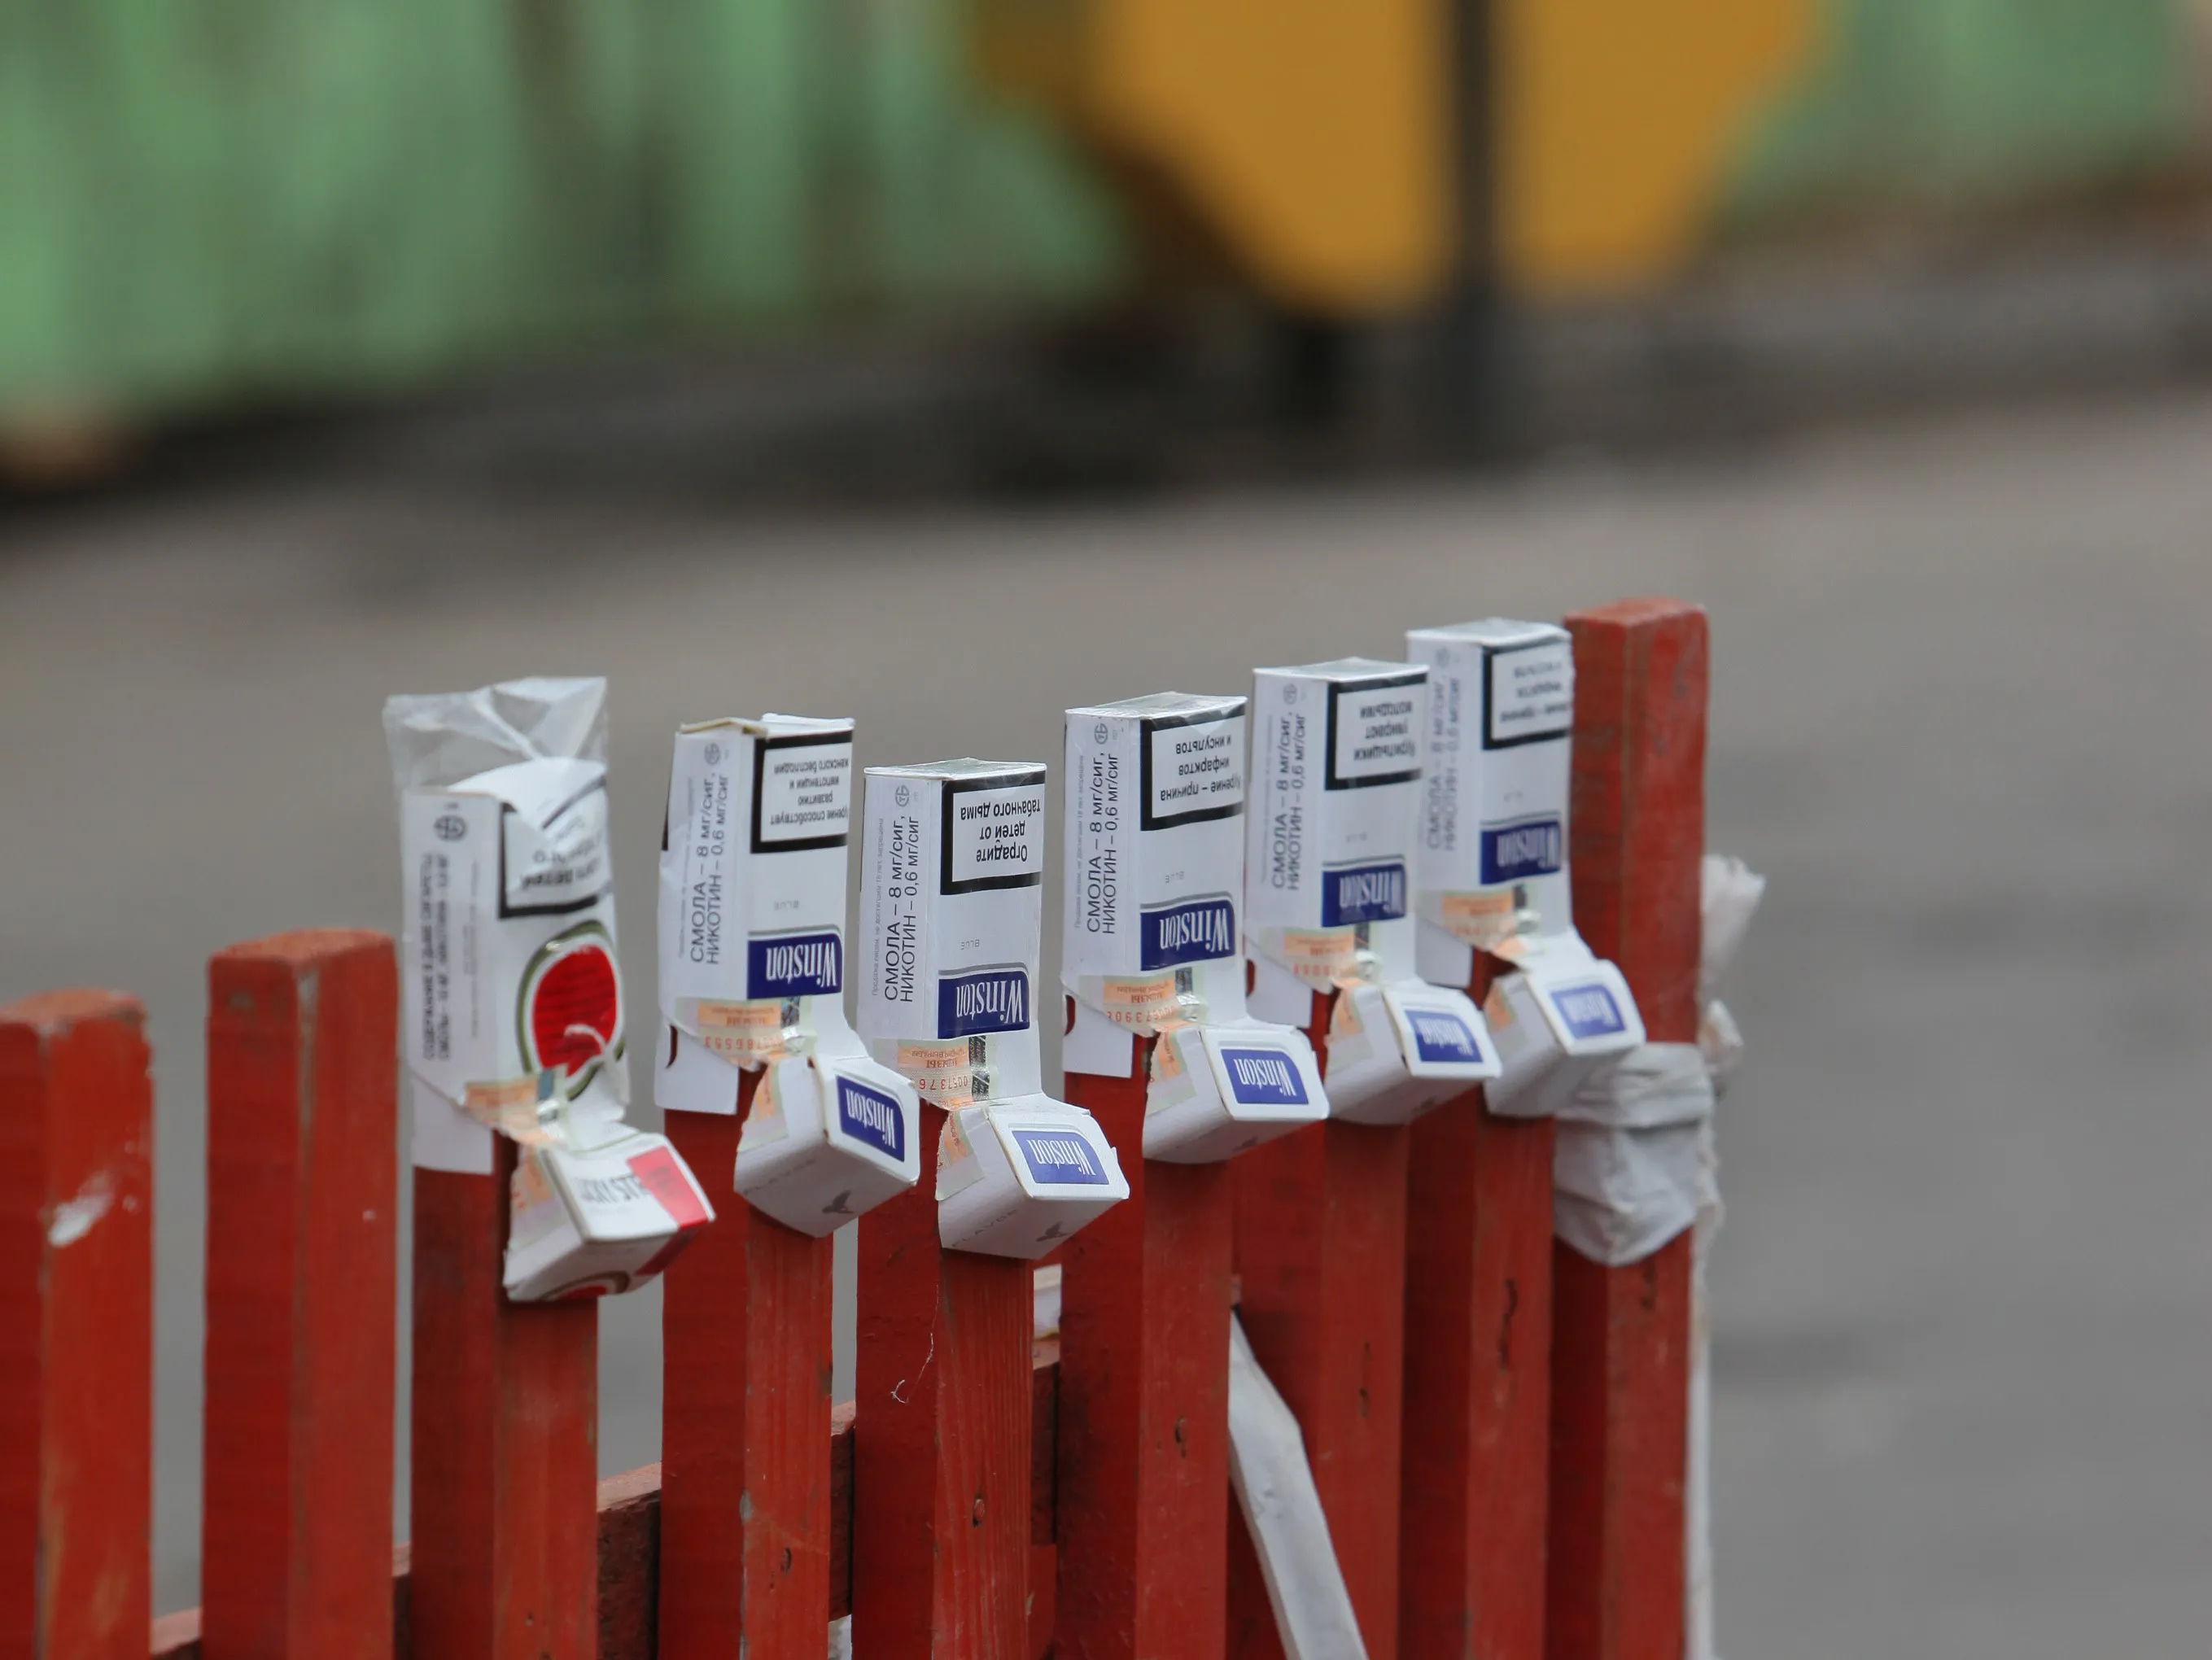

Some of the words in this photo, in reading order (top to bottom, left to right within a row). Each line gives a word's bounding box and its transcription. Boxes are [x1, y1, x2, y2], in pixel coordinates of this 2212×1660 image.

[1175, 735, 1225, 754] инсультов
[1226, 734, 1232, 746] и
[1105, 754, 1119, 802] мг/сиг
[1178, 756, 1230, 776] инфарктов
[1292, 764, 1305, 789] 0,6
[796, 776, 839, 789] импотенции
[1091, 751, 1104, 816] мг/сиг,
[1161, 781, 1199, 802] причина
[1277, 778, 1290, 791] 8
[715, 775, 729, 827] мг/сиг
[798, 791, 833, 806] развитию
[960, 802, 990, 820] дыма
[993, 799, 1041, 817] табачного
[770, 810, 825, 826] способствует
[1090, 820, 1103, 832] 8
[1105, 805, 1119, 831] 0,6
[711, 829, 725, 855] 0,6
[905, 818, 920, 867] мг/сиг
[979, 826, 992, 839] от
[995, 821, 1025, 844] детей
[697, 845, 708, 856] 8
[890, 815, 906, 881] мг/сиг,
[976, 845, 1028, 863] Оградите
[1272, 812, 1288, 888] СМОЛА
[1287, 806, 1304, 891] НИКОТИН
[889, 888, 902, 898] 8
[905, 870, 920, 897] 0,6
[1086, 854, 1102, 933] СМОЛА
[1102, 850, 1117, 934] НИКОТИН
[1339, 870, 1404, 912] Winston
[690, 881, 706, 962] СМОЛА
[706, 876, 723, 965] НИКОТИН
[1159, 906, 1231, 952] Winston
[960, 939, 980, 950] BLUE
[765, 941, 837, 988] Winston
[885, 921, 901, 1001] СМОЛА
[900, 915, 916, 1003] НИКОТИН
[955, 978, 1024, 1024] Winston
[1233, 1058, 1297, 1097] Winston
[846, 1088, 896, 1150] Winston
[1026, 1137, 1096, 1177] Winston
